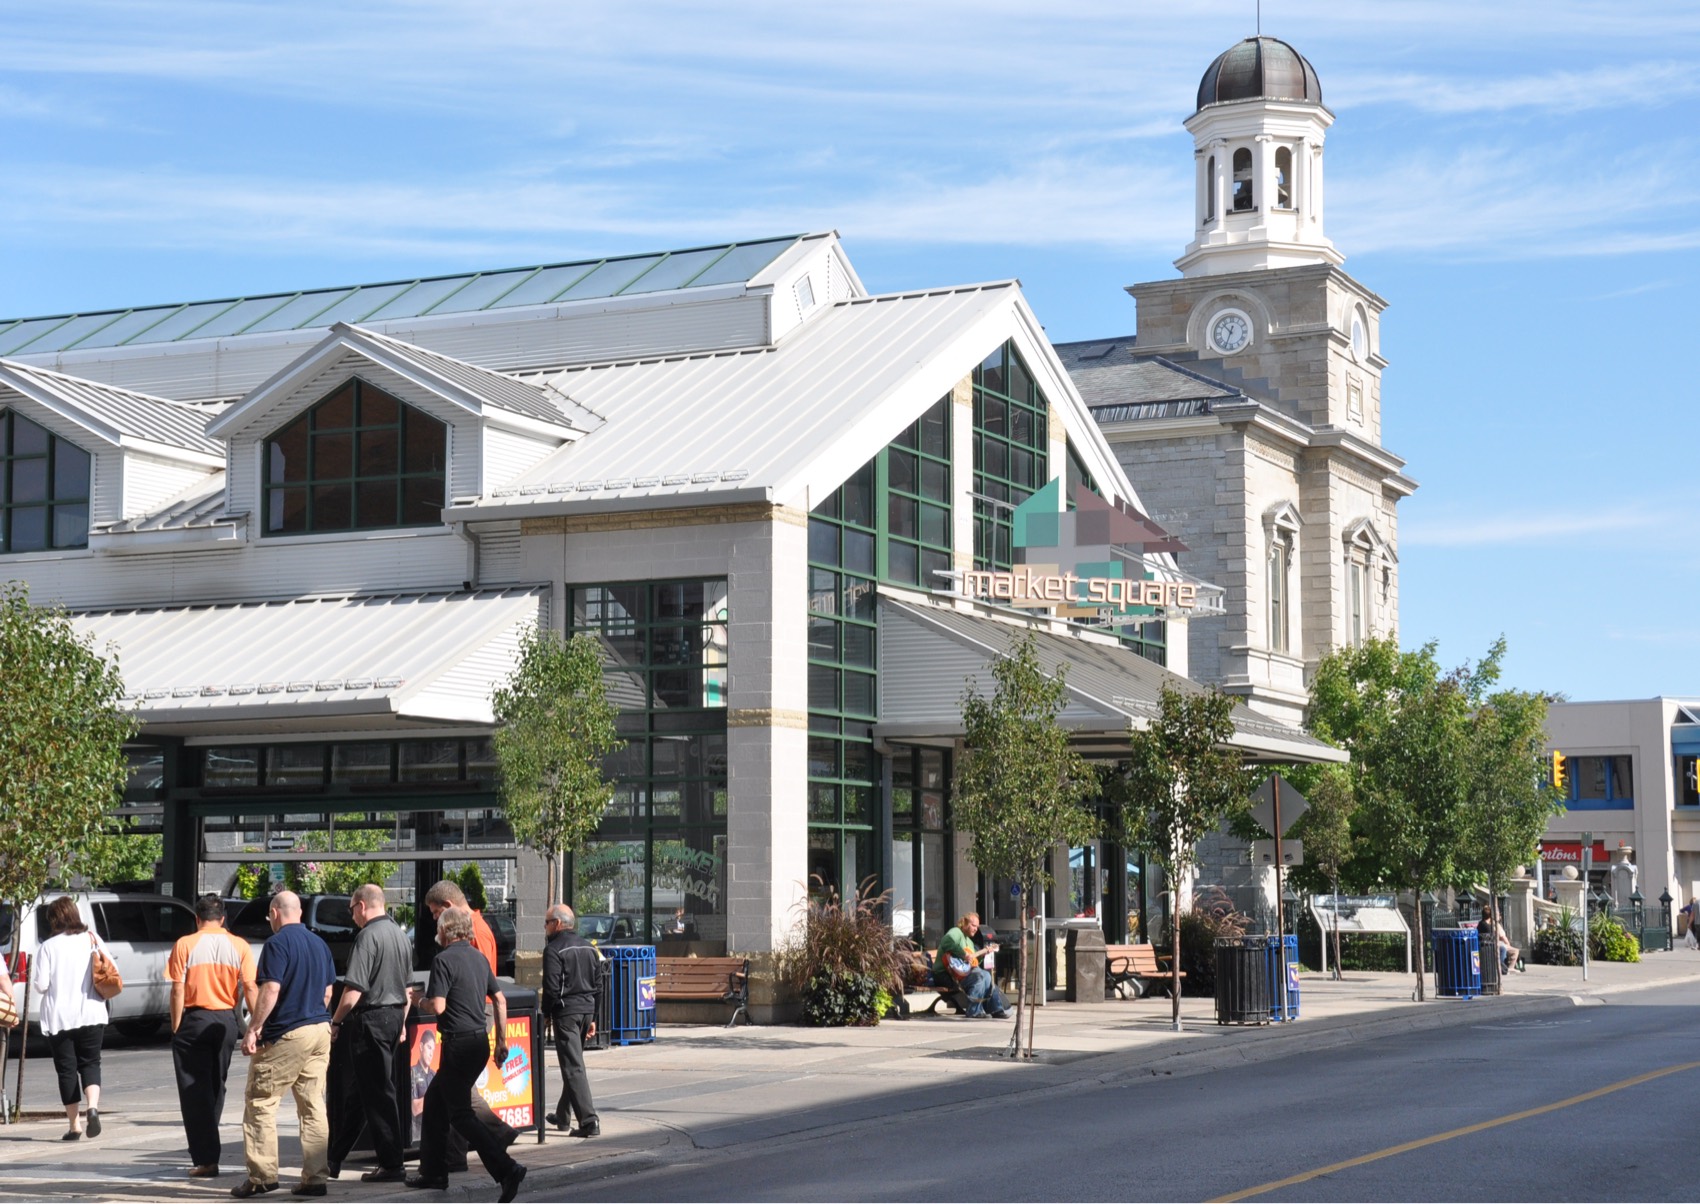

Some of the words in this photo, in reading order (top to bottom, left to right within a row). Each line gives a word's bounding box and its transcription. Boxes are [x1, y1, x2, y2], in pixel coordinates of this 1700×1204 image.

[962, 567, 1079, 601] market
[1087, 577, 1196, 613] square
[1541, 847, 1576, 861] ortons
[506, 1055, 523, 1072] FREE
[483, 1089, 507, 1105] Byers
[499, 1107, 530, 1127] 7685
